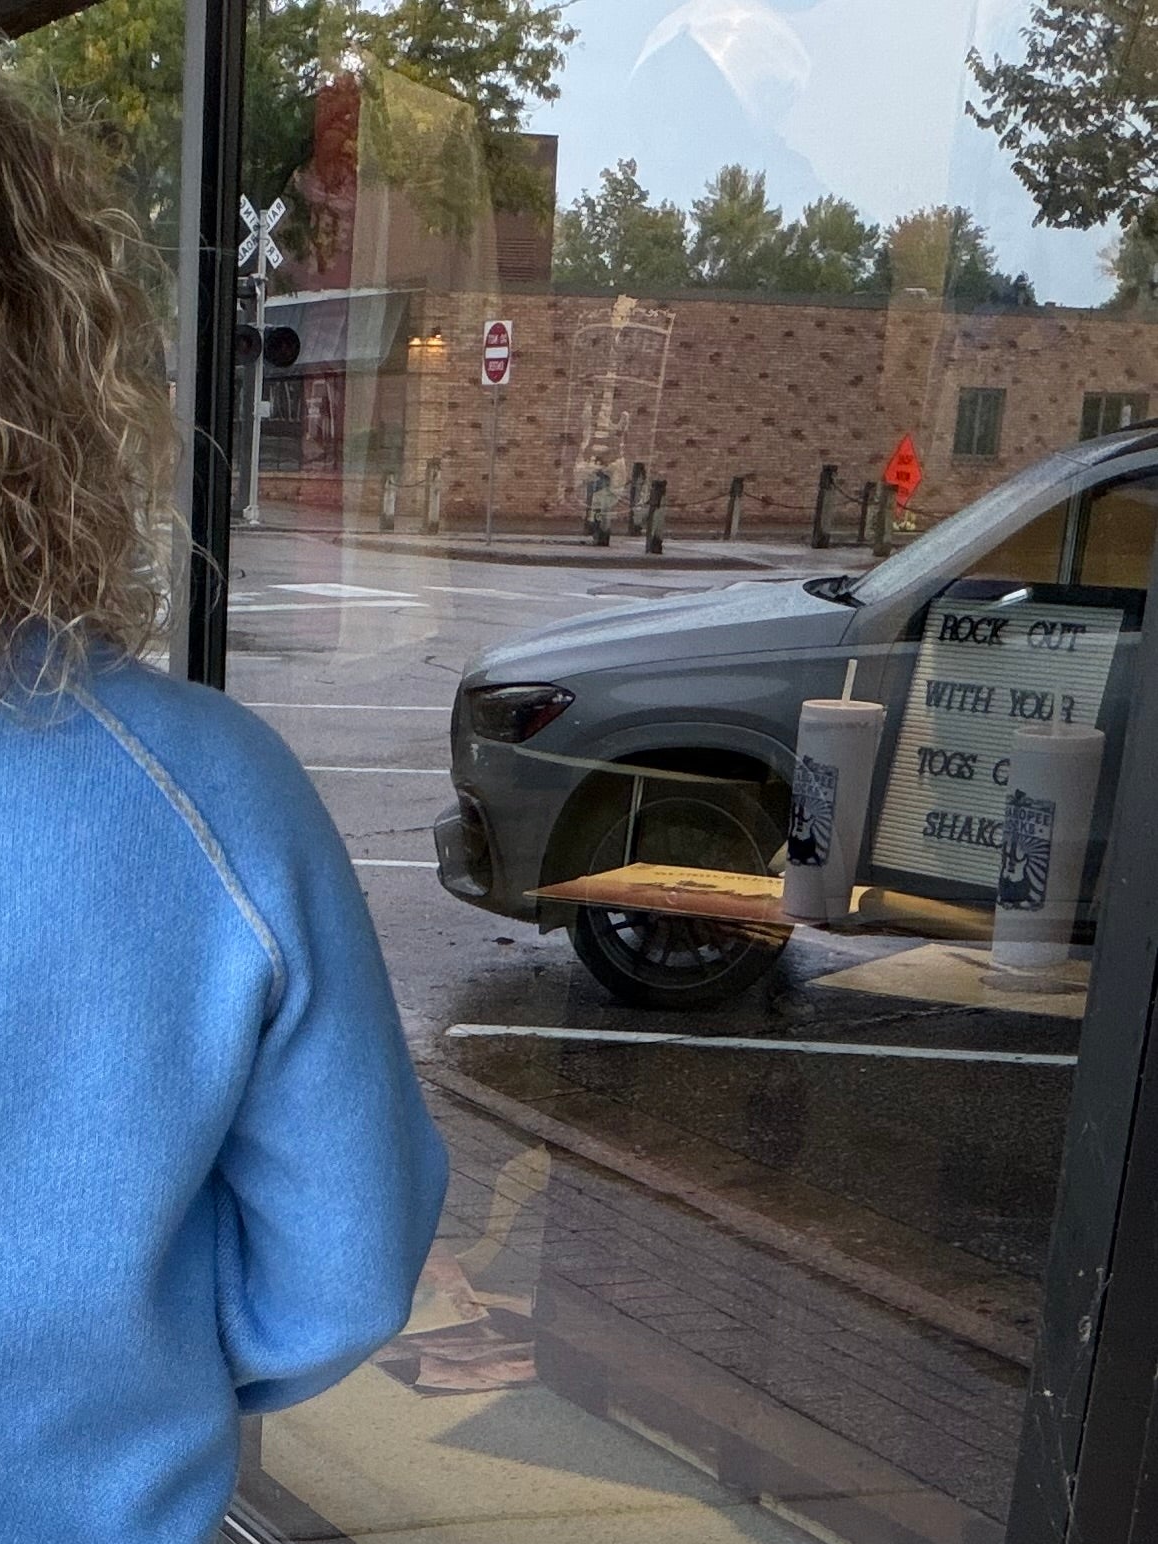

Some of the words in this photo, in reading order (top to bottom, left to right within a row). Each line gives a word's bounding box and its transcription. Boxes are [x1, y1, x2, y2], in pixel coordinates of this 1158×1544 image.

[938, 613, 1009, 645] ROCK
[1028, 620, 1086, 651] OUT
[926, 680, 995, 713] WITH
[1009, 688, 1075, 723] YOUR
[918, 747, 978, 780] TOGS
[923, 812, 1003, 848] SHAKO
